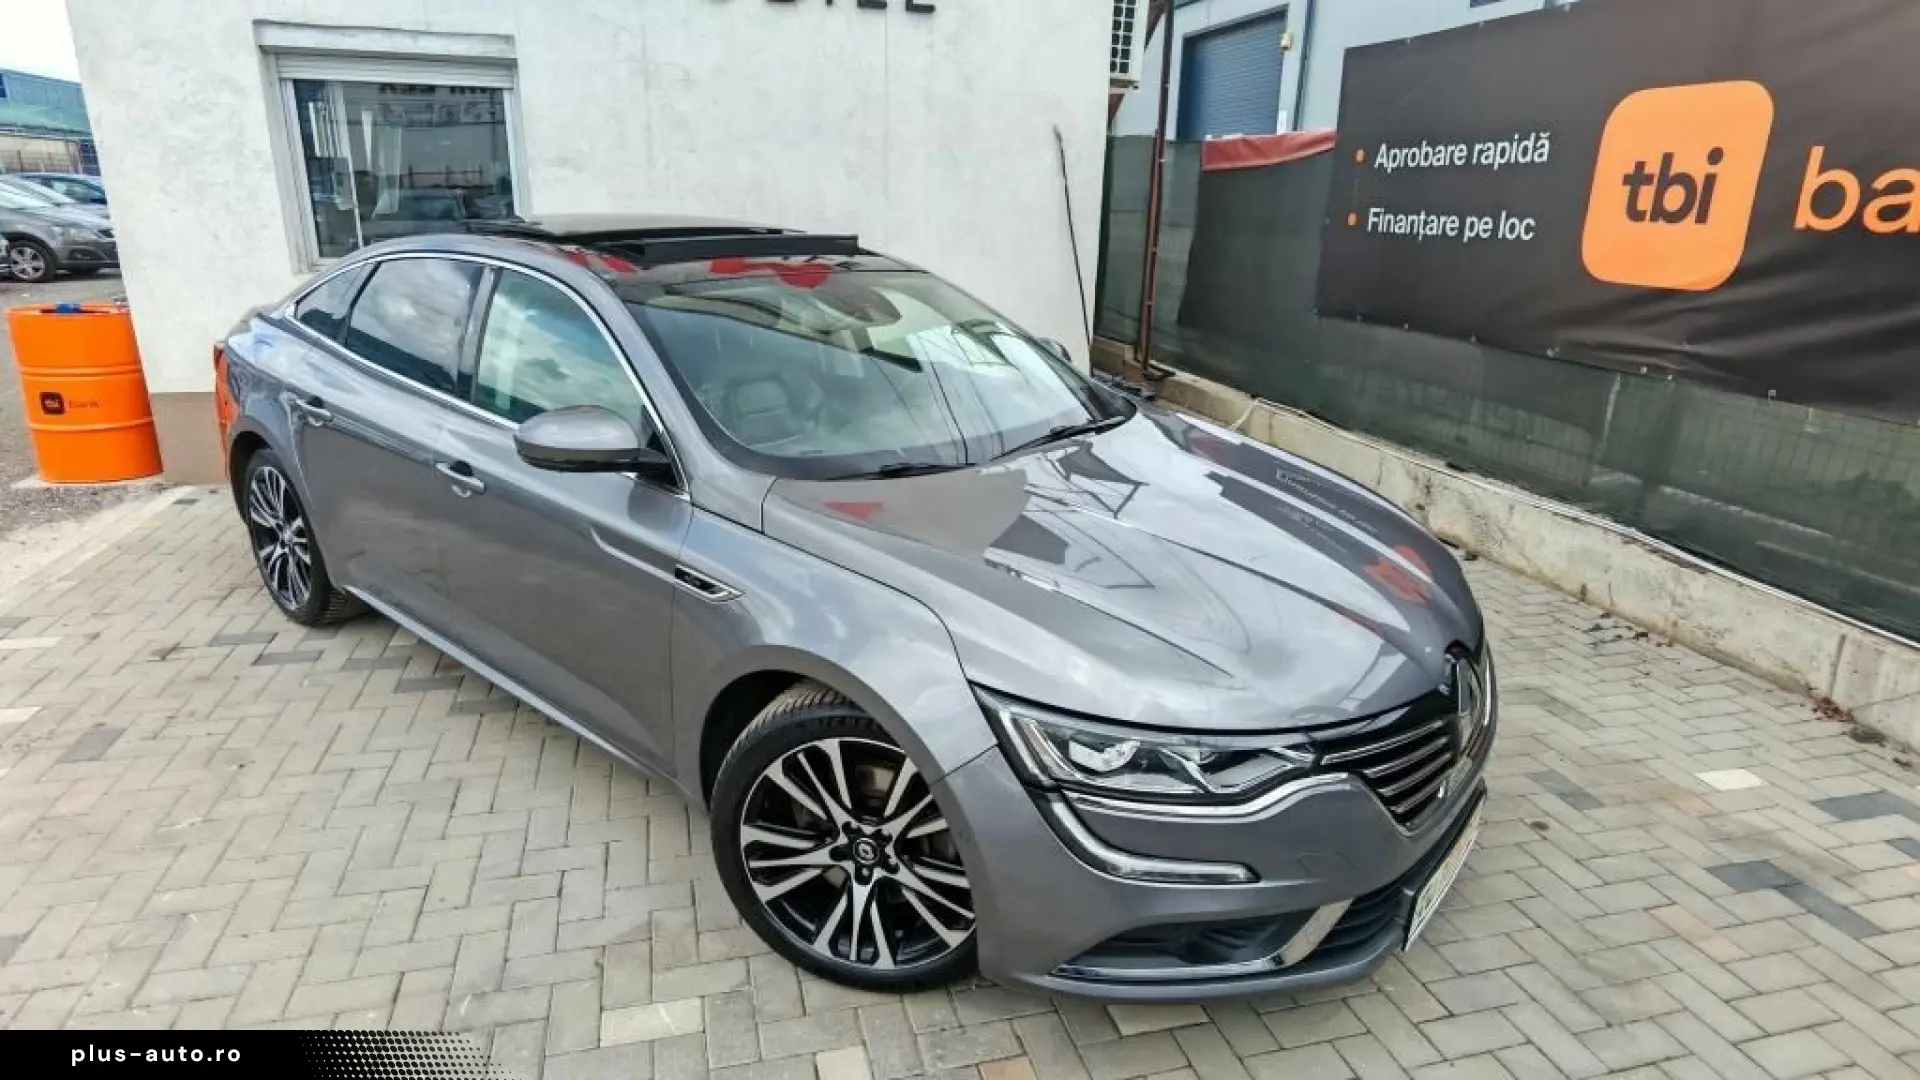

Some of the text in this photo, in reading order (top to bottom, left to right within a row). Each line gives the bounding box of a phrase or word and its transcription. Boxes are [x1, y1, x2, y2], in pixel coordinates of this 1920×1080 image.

[1374, 131, 1552, 174] Aprobare rapidă
[1622, 147, 1724, 225] tbi
[1367, 207, 1536, 243] Finanțare pe loc
